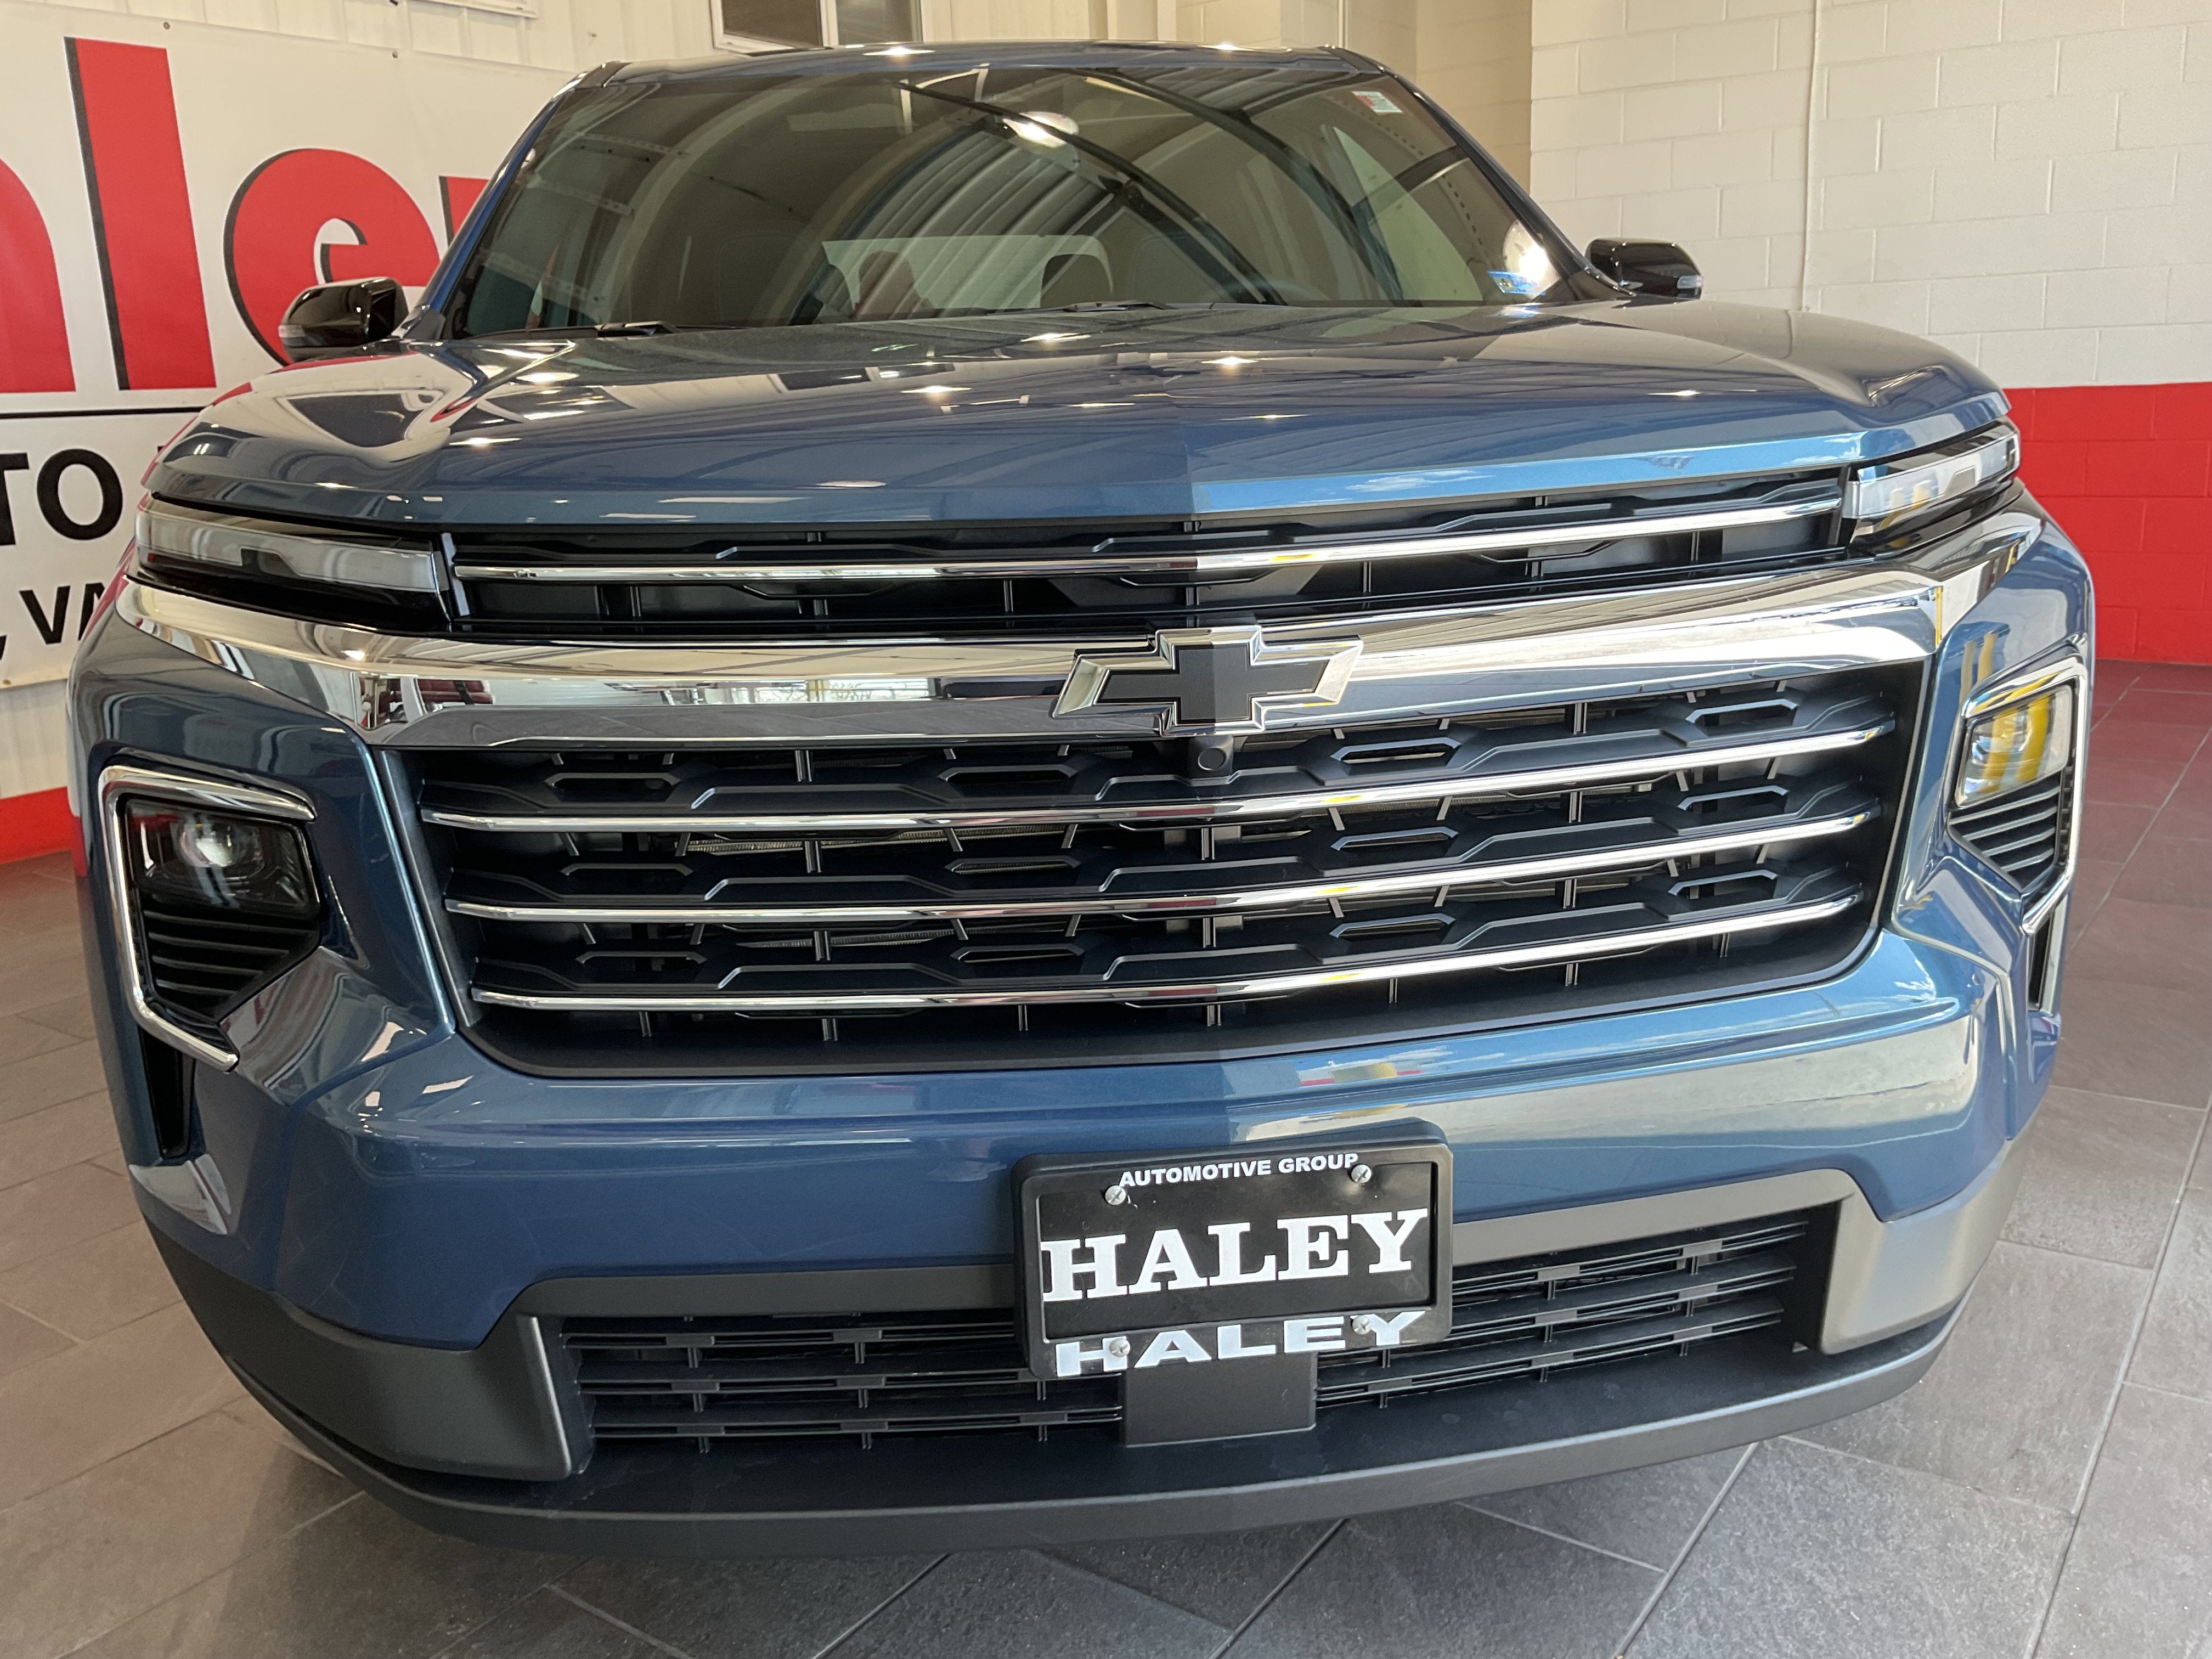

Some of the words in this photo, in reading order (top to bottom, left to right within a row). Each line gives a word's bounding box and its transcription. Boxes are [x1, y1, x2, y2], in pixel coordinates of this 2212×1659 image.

[0, 37, 489, 394] le
[1120, 1160, 1271, 1187] AUTOMOTIVE
[1278, 1153, 1358, 1173] GROUP
[1040, 1209, 1428, 1302] HALEY
[1056, 1311, 1426, 1377] HALEY
